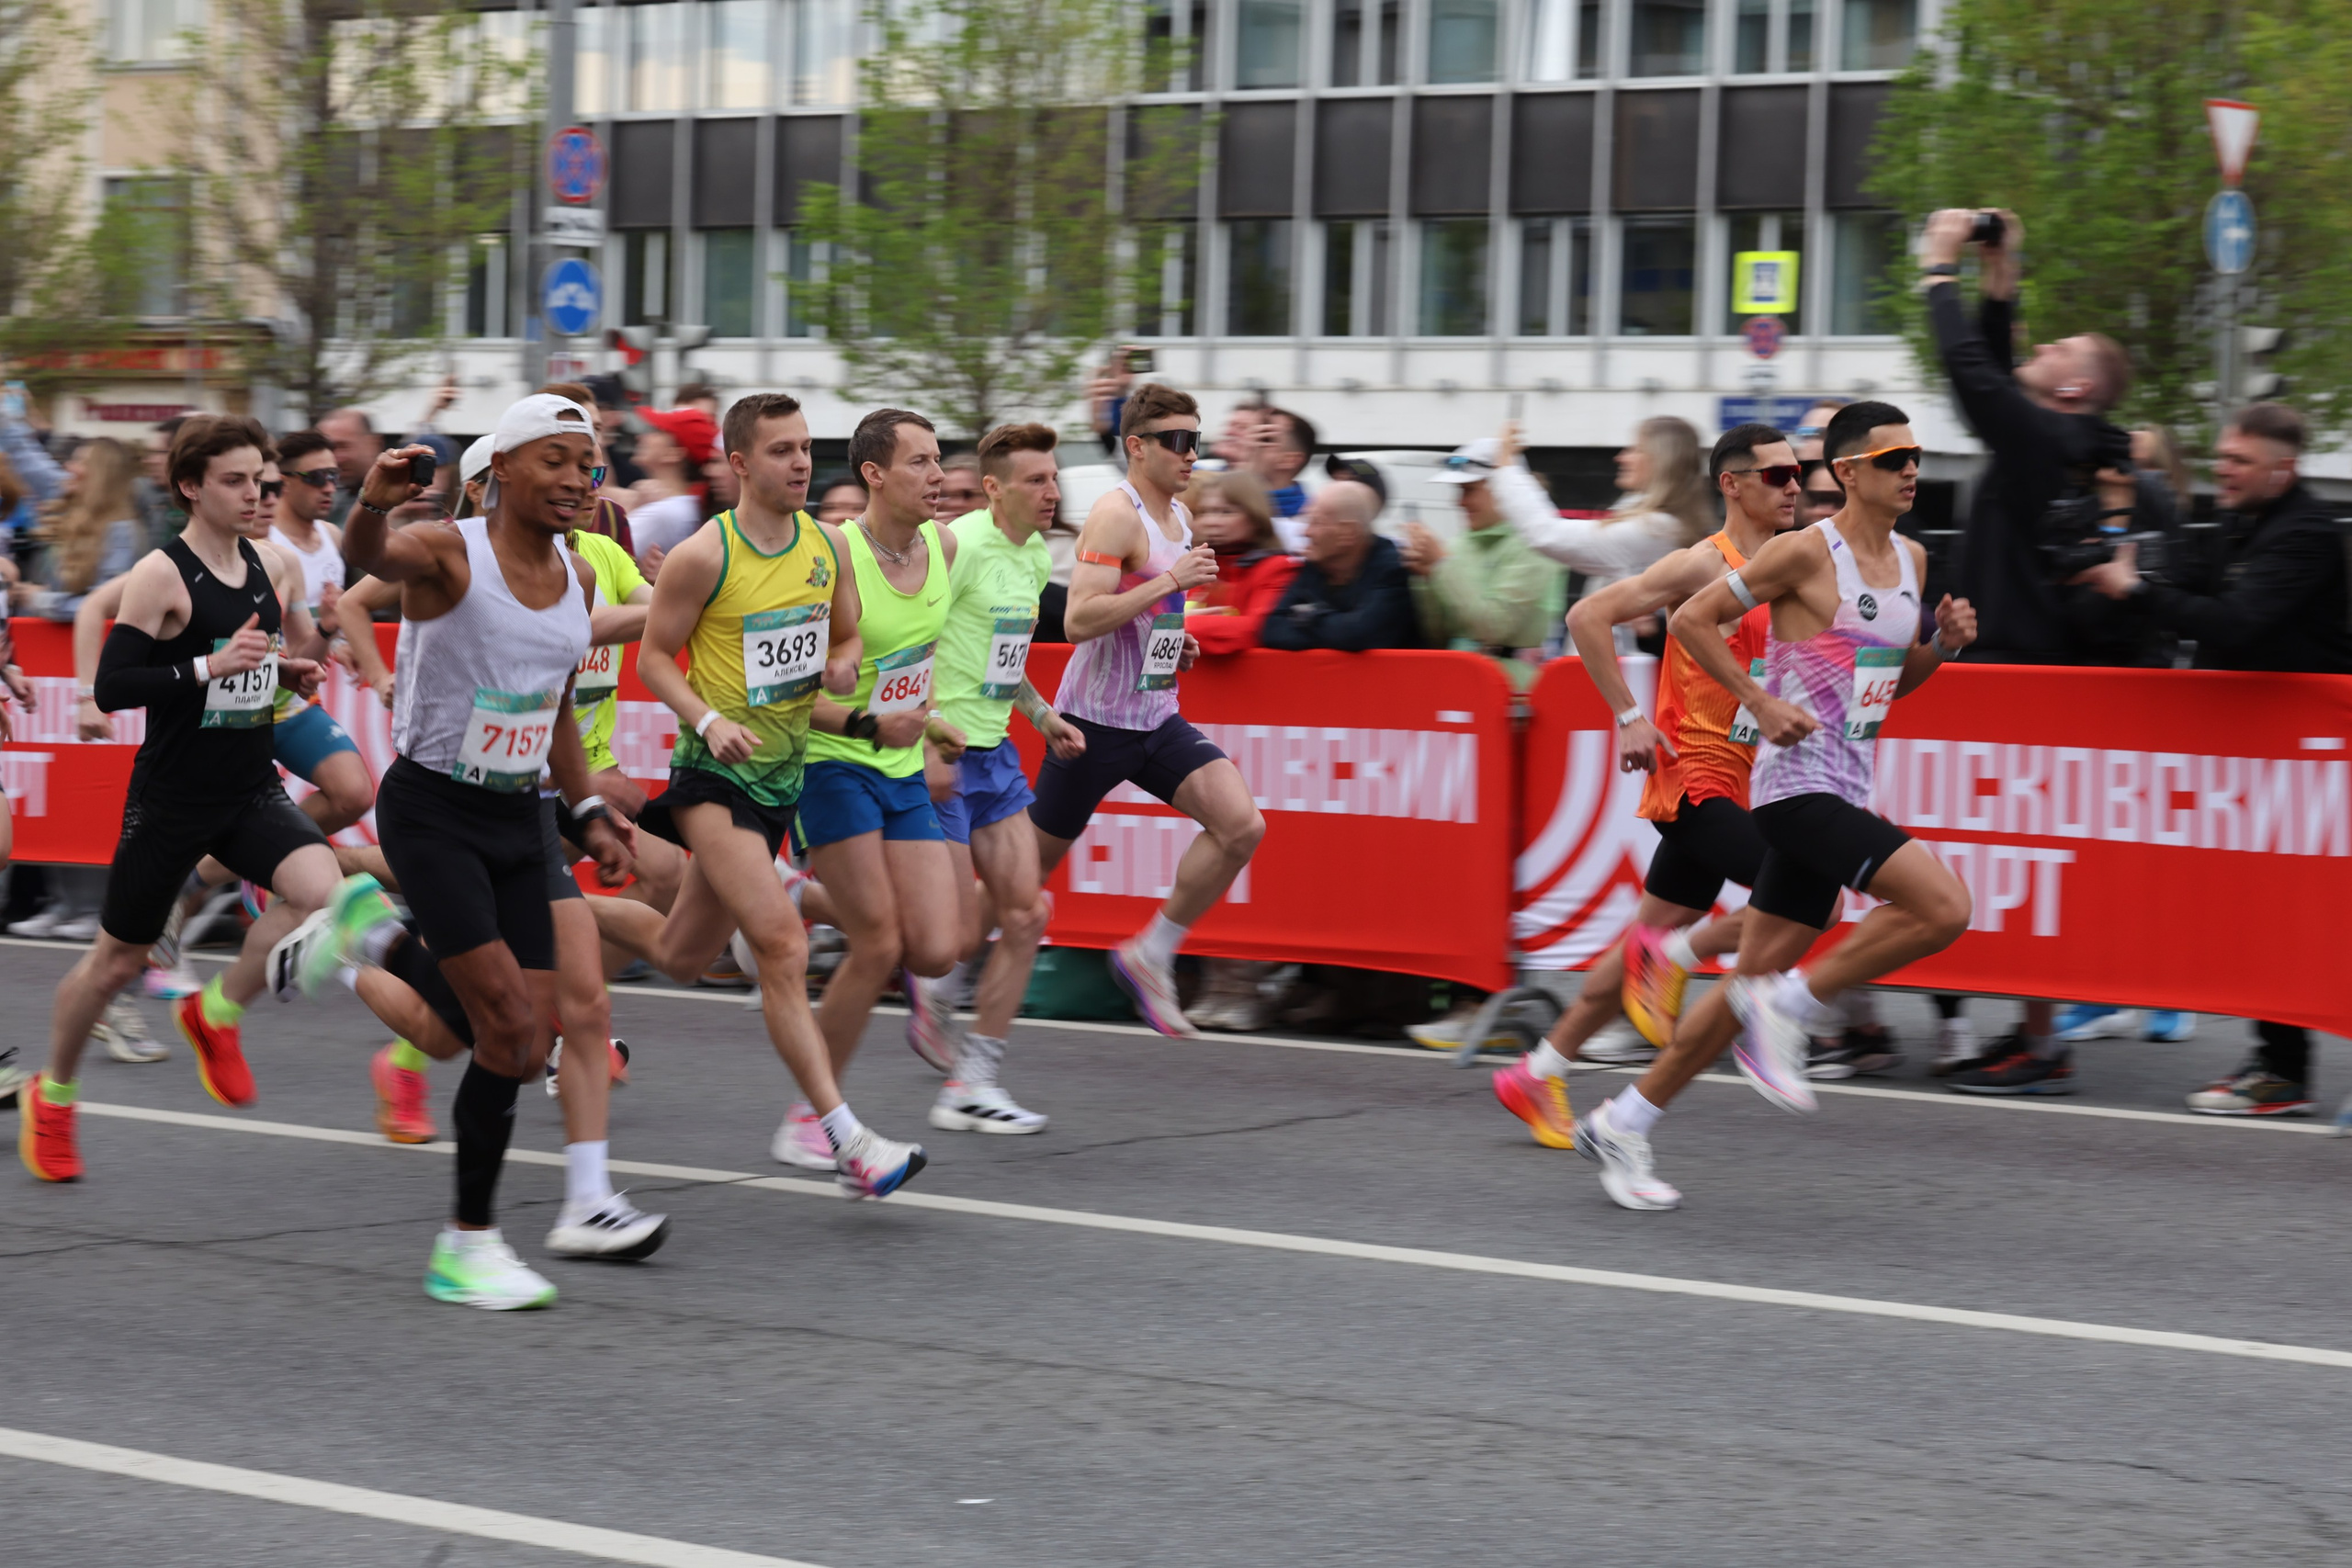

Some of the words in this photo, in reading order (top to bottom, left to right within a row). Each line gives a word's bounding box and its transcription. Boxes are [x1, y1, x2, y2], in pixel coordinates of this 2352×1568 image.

[757, 631, 818, 668] 3693
[774, 663, 808, 678] АЛЕКСЕЙ
[481, 722, 548, 758] 7157
